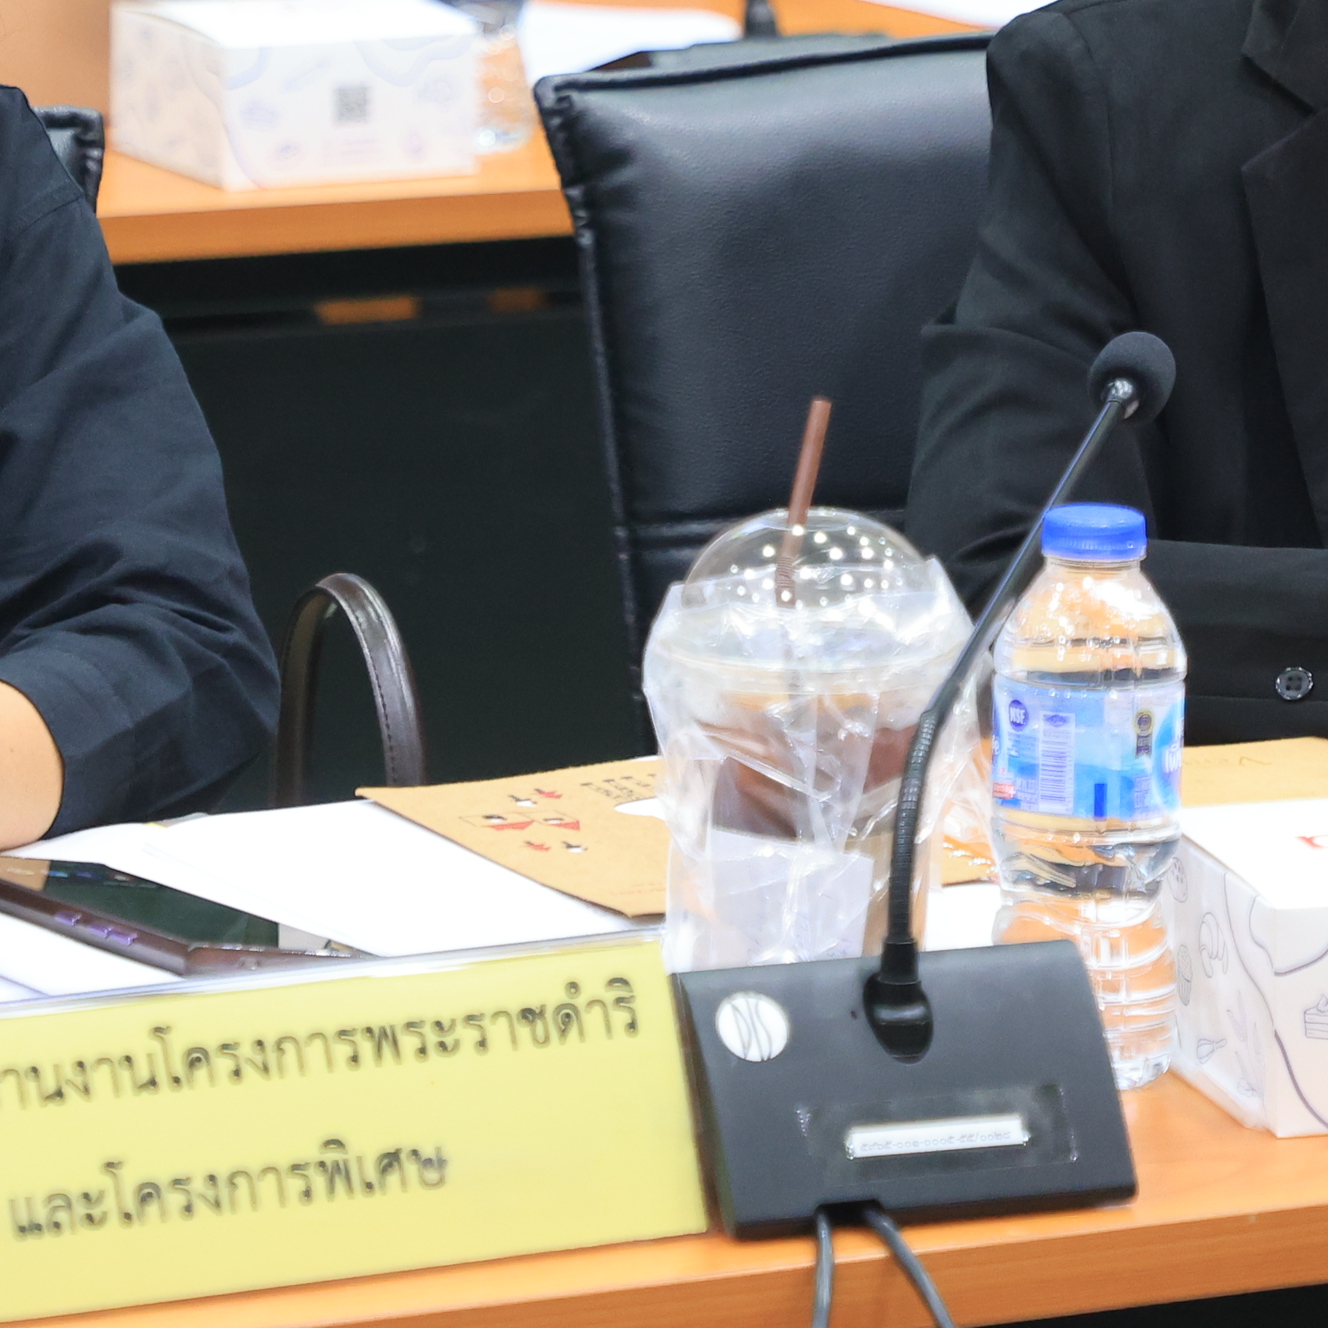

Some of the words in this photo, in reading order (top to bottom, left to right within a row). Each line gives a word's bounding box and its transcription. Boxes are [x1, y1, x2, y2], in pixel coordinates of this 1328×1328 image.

[9, 1139, 449, 1241] และโครงการพิเศษ
